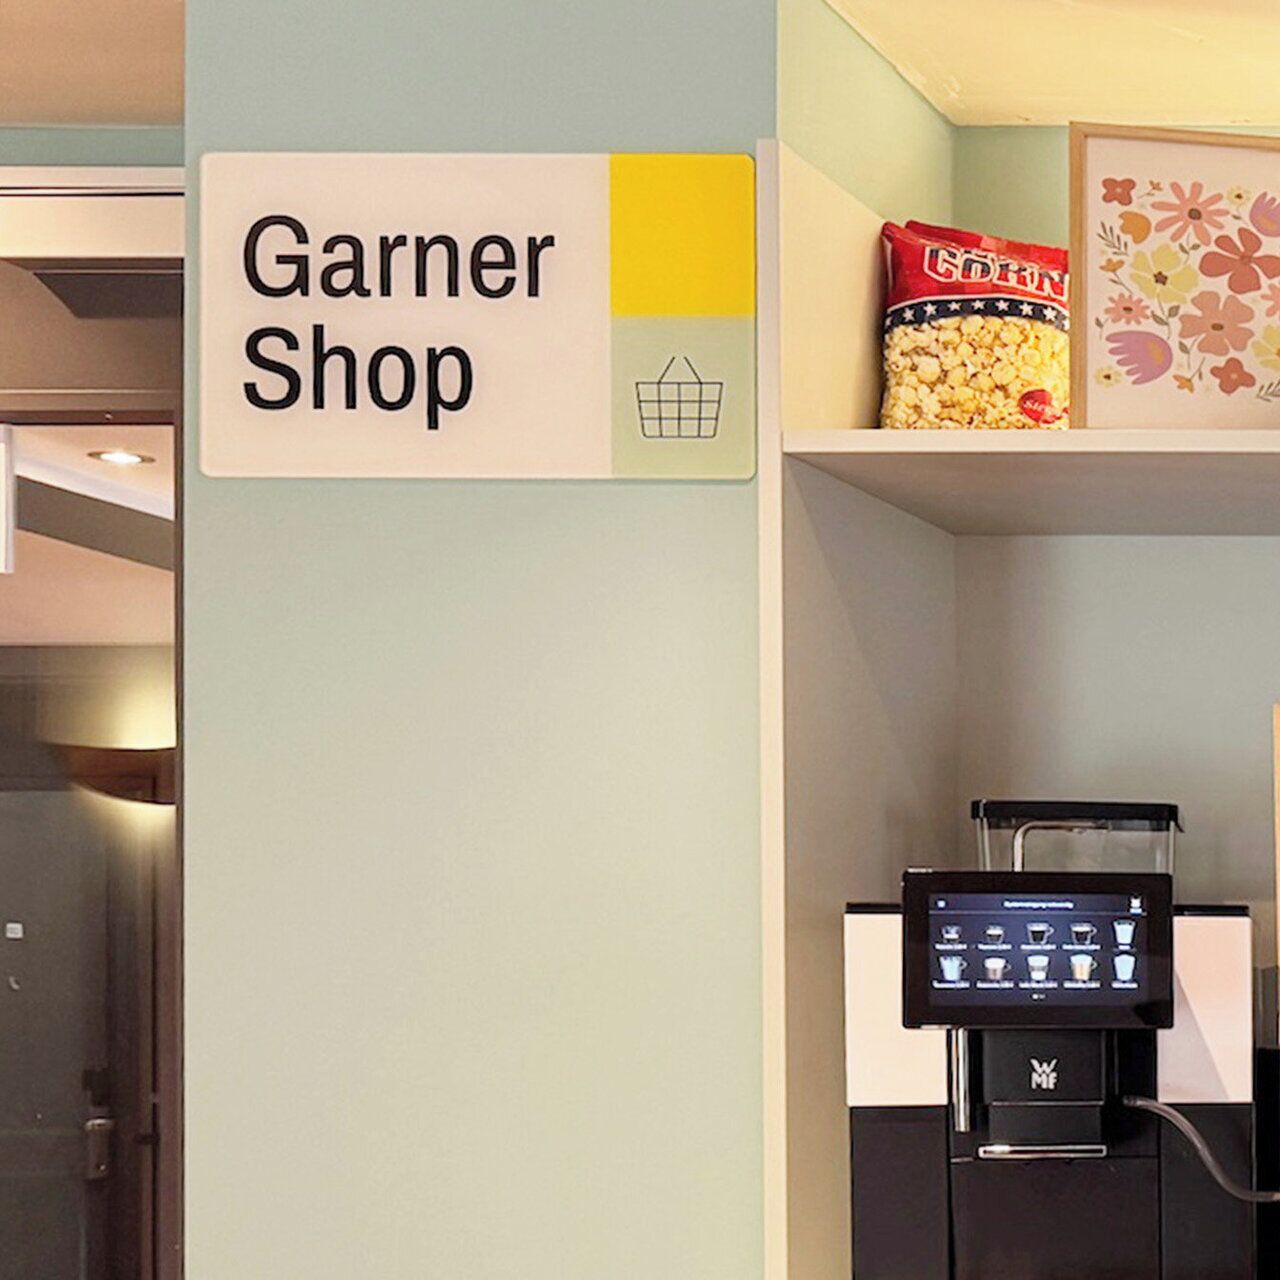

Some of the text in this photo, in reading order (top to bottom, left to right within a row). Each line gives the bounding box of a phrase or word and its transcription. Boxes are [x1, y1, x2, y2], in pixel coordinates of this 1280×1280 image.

[243, 214, 556, 299] Garner
[923, 246, 1068, 302] CORN
[243, 323, 474, 431] Shop
